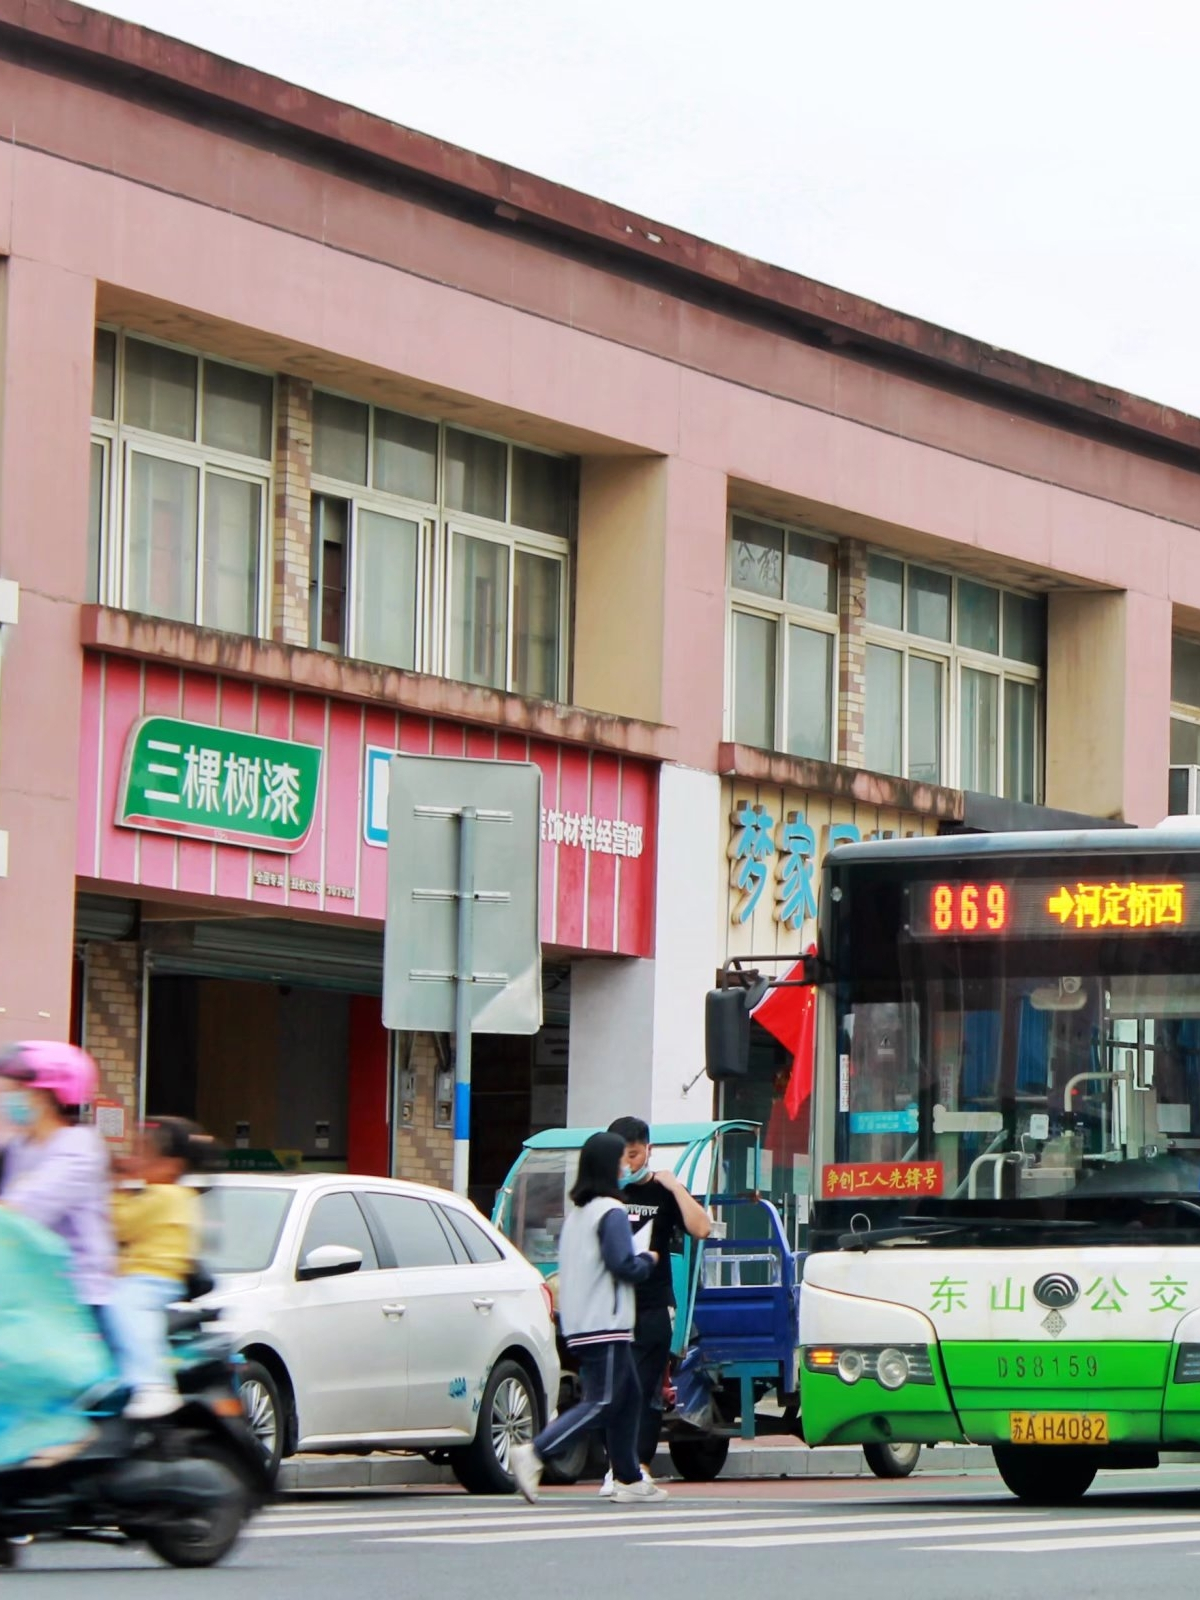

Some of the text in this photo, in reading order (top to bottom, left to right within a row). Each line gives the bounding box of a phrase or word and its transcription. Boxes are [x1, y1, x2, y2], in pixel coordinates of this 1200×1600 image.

[143, 739, 300, 826] 三棵树漆
[541, 807, 643, 858] 饰材料经营部
[730, 799, 862, 930] 梦家
[934, 885, 1006, 930] 869
[929, 1275, 1188, 1314] 东山公交
[996, 1354, 1099, 1379] DS8159
